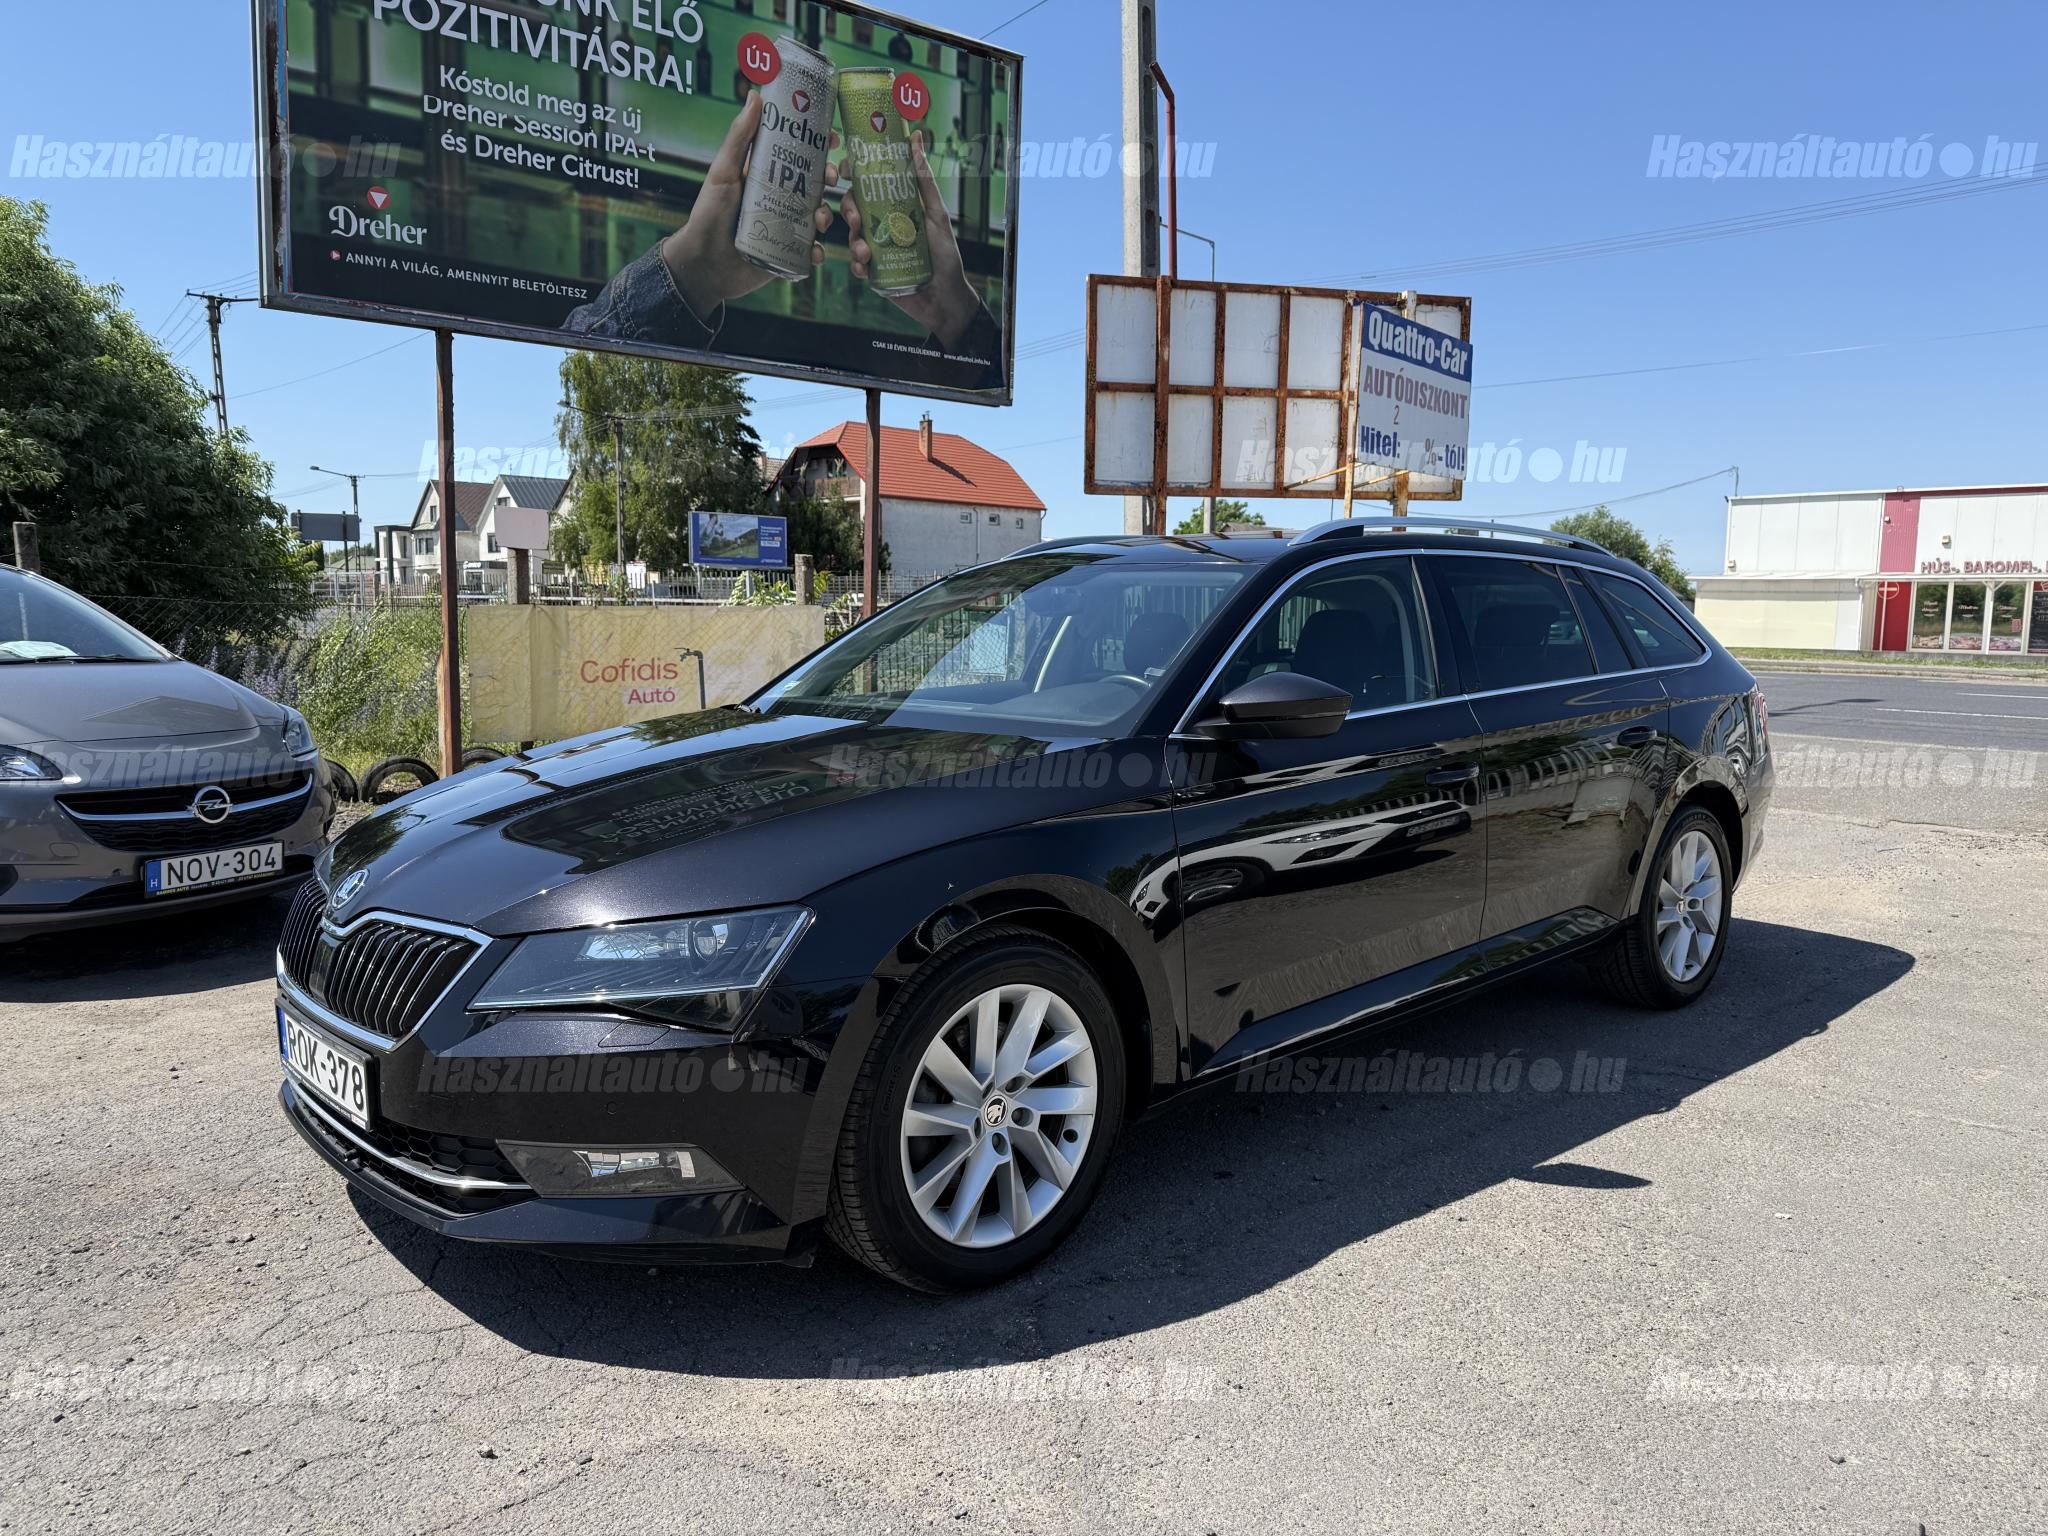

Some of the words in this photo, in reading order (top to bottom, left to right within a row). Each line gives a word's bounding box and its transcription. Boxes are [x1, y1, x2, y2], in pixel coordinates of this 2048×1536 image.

[373, 0, 693, 95] POZITIVITÁSRA!
[746, 45, 771, 72] ÚJ
[440, 64, 529, 107] Kóstold
[537, 92, 587, 124] meg
[591, 103, 617, 124] az
[622, 106, 642, 134] új
[900, 83, 921, 108] ÚJ
[513, 114, 598, 149] Session
[605, 131, 656, 162] IPA-t
[772, 143, 812, 173] SESSION
[440, 129, 467, 153] és
[475, 135, 555, 171] Dreher
[561, 155, 639, 188] Citrust!
[768, 159, 806, 198] IPA
[860, 171, 916, 205] CITRUS
[328, 205, 428, 246] Dreher
[345, 252, 386, 268] ANNYI
[390, 259, 399, 270] A
[402, 261, 444, 278] VILÁG,
[447, 268, 509, 288] AMENNYIT
[512, 278, 588, 299] BELETÖLTESZ
[1368, 310, 1468, 376] Quattro-Car
[1363, 365, 1468, 420] AUTÓDISZKONT
[1393, 404, 1400, 425] 2
[1360, 425, 1401, 459] Hitel:
[580, 657, 679, 684] Cofidis
[627, 686, 676, 705] Autó
[167, 846, 277, 886] NOV-304
[286, 1019, 364, 1113] ROK-378
